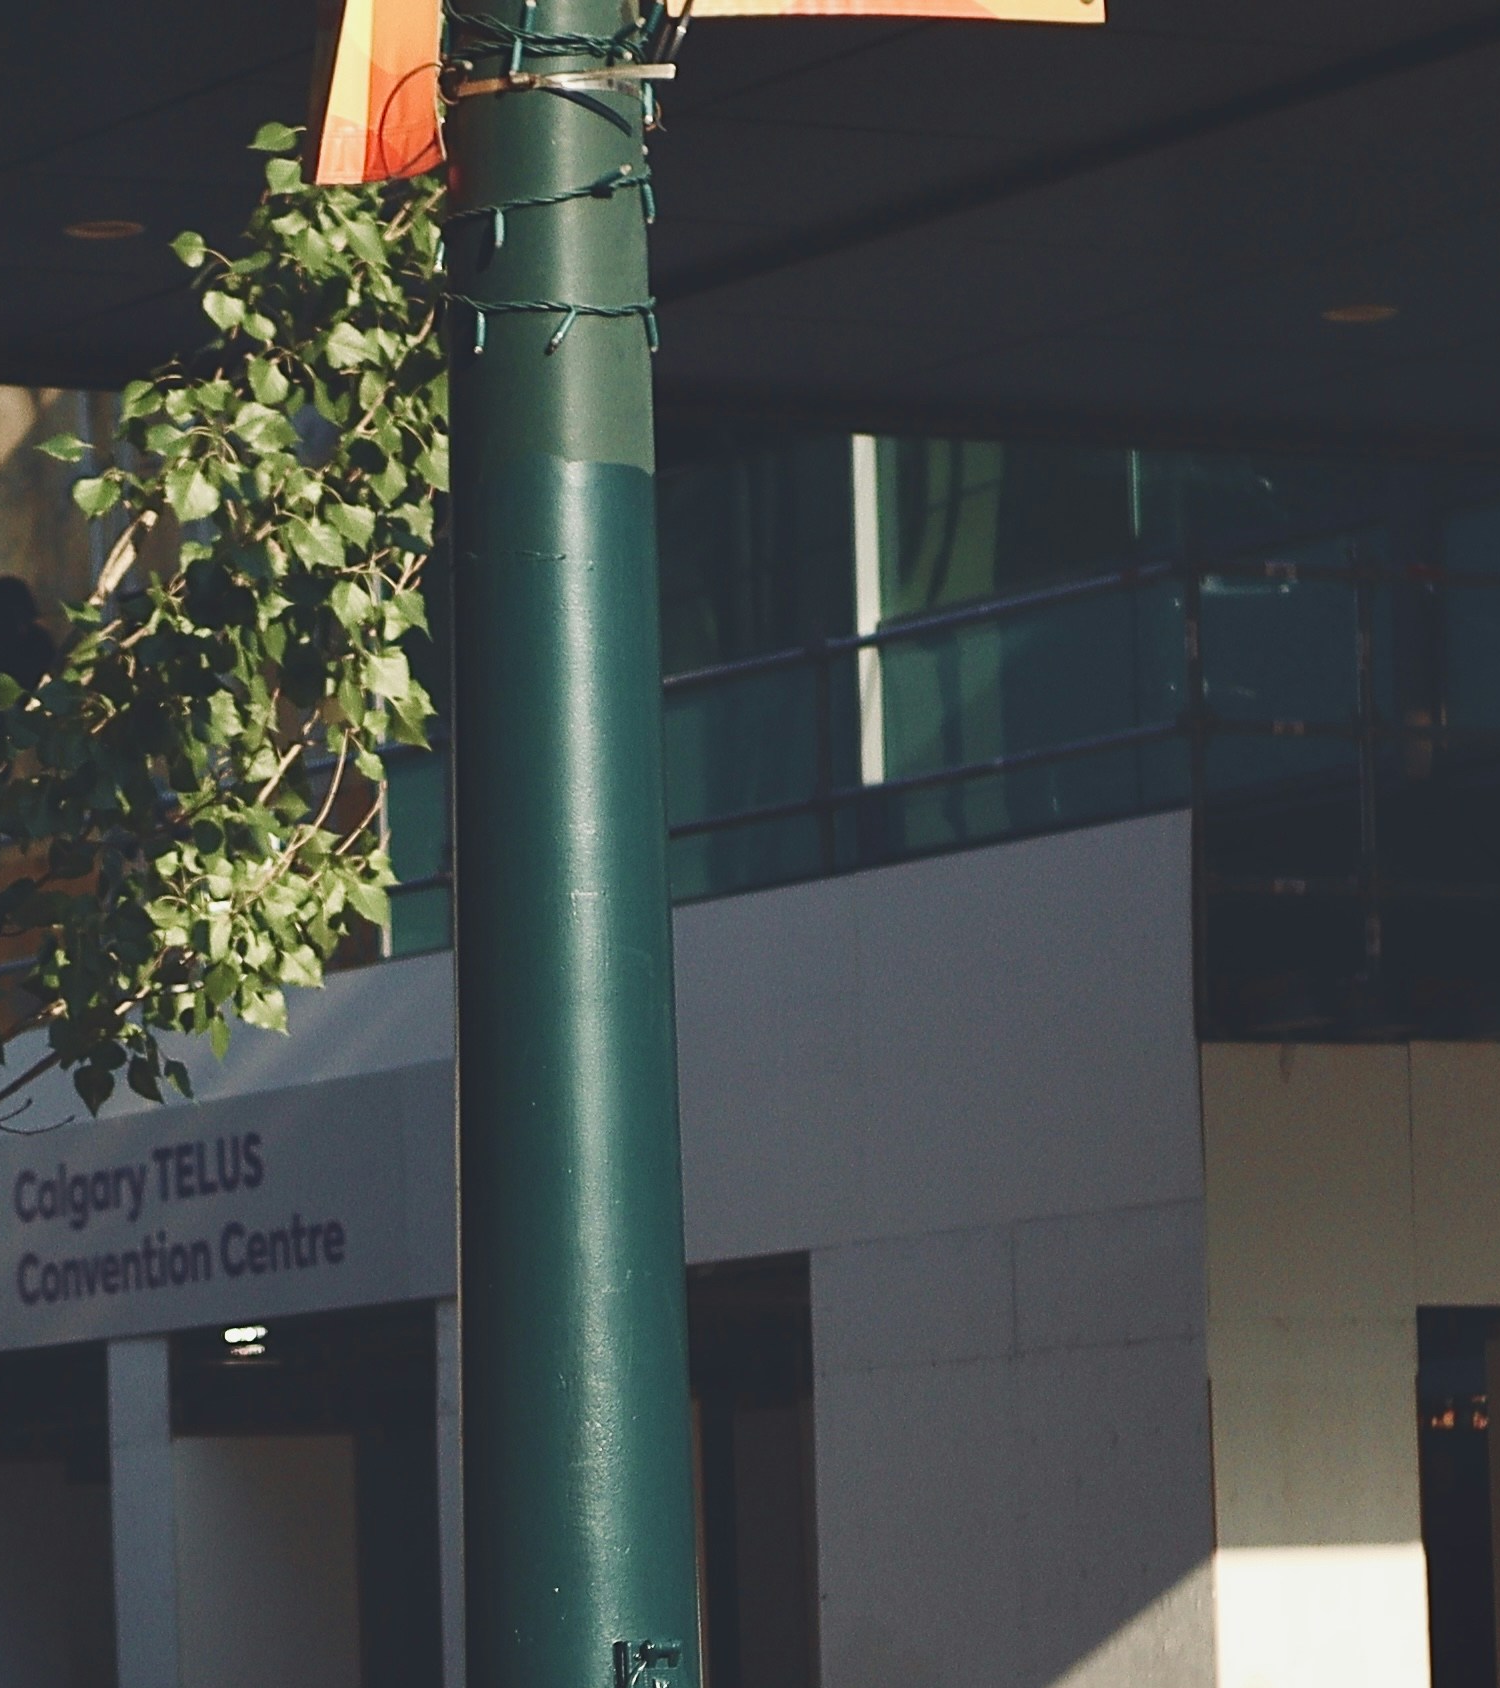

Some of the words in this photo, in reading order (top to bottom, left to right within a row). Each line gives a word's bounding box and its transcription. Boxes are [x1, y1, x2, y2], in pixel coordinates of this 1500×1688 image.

[13, 1162, 148, 1231] Calgary
[152, 1131, 264, 1202] TELUS
[17, 1229, 213, 1306] Convention
[219, 1212, 347, 1279] Centre
